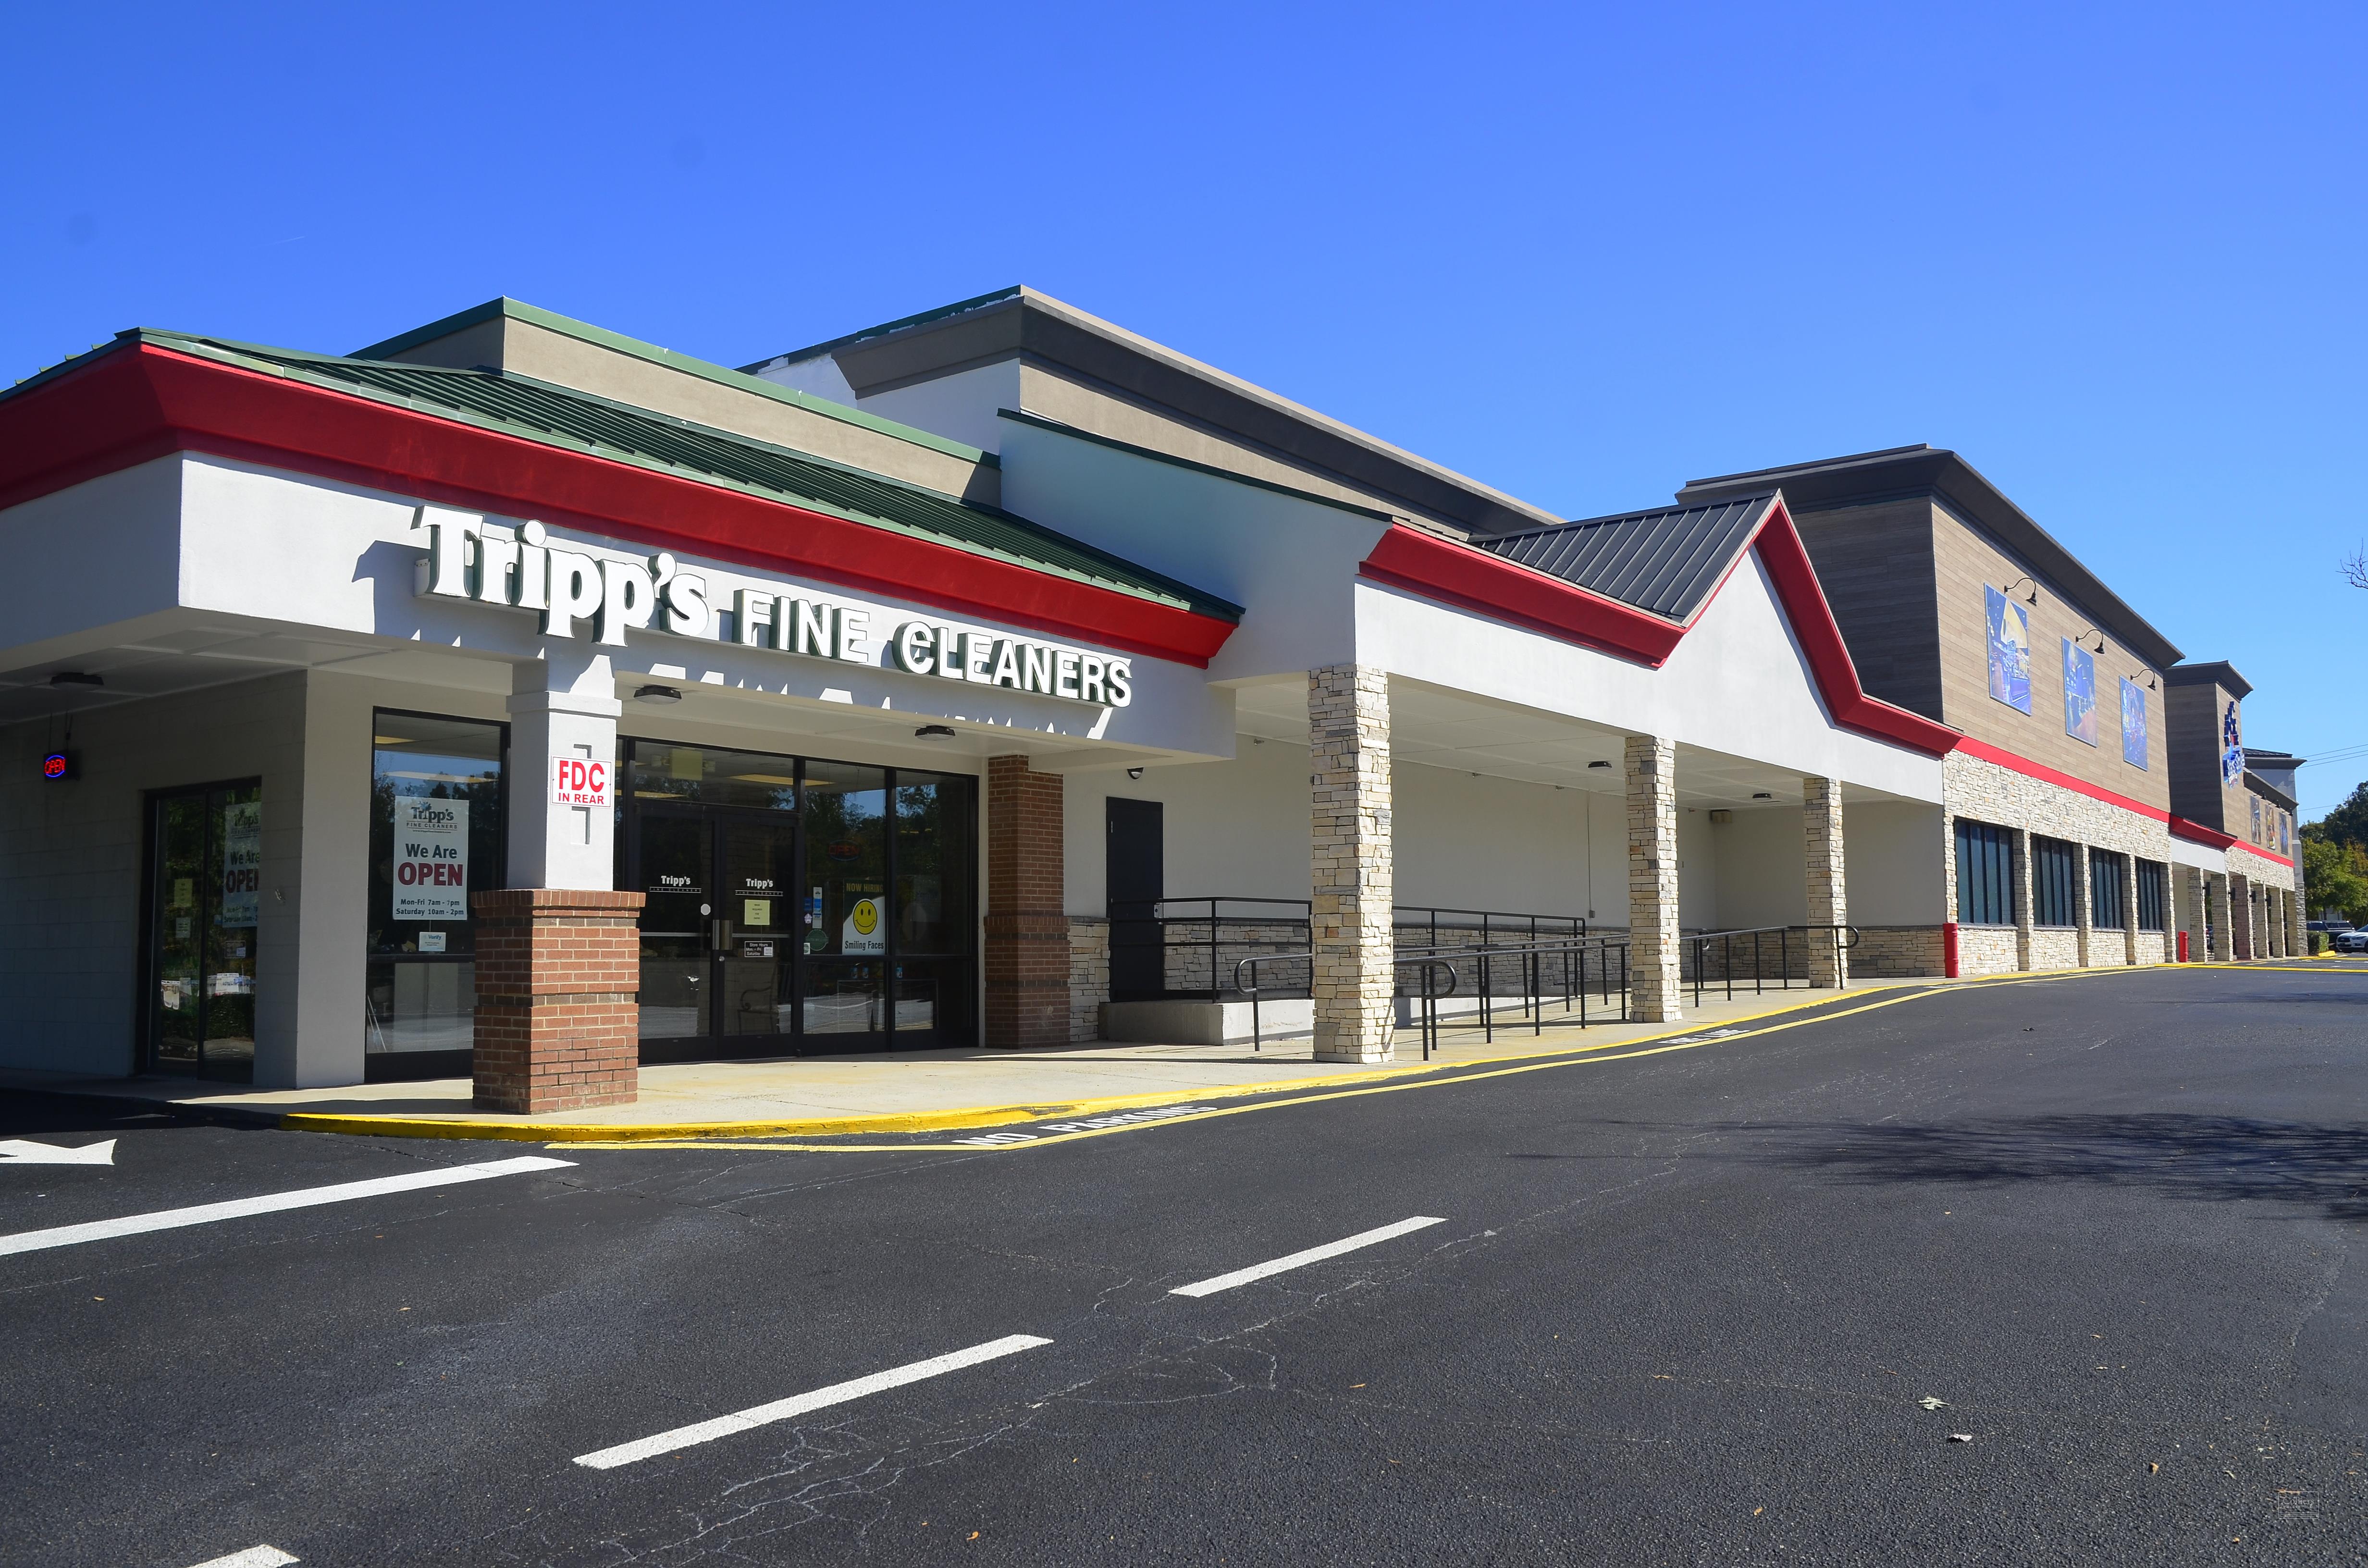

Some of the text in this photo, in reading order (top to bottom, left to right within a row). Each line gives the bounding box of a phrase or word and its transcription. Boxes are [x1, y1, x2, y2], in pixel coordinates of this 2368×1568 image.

[414, 504, 1132, 708] Tripp's FINE CLEANERS
[559, 760, 605, 793] FDC
[558, 792, 604, 804] IN REAR
[411, 803, 455, 823] Tripp's
[230, 851, 243, 865] We
[405, 844, 457, 859] We Are
[398, 862, 463, 886] OPEN
[661, 875, 691, 887] Tripp's
[746, 878, 773, 889] Tripp's
[846, 883, 884, 893] NOW HIRING
[845, 941, 884, 951] Smiling Faces
[951, 1105, 1219, 1146] NO PARKING
